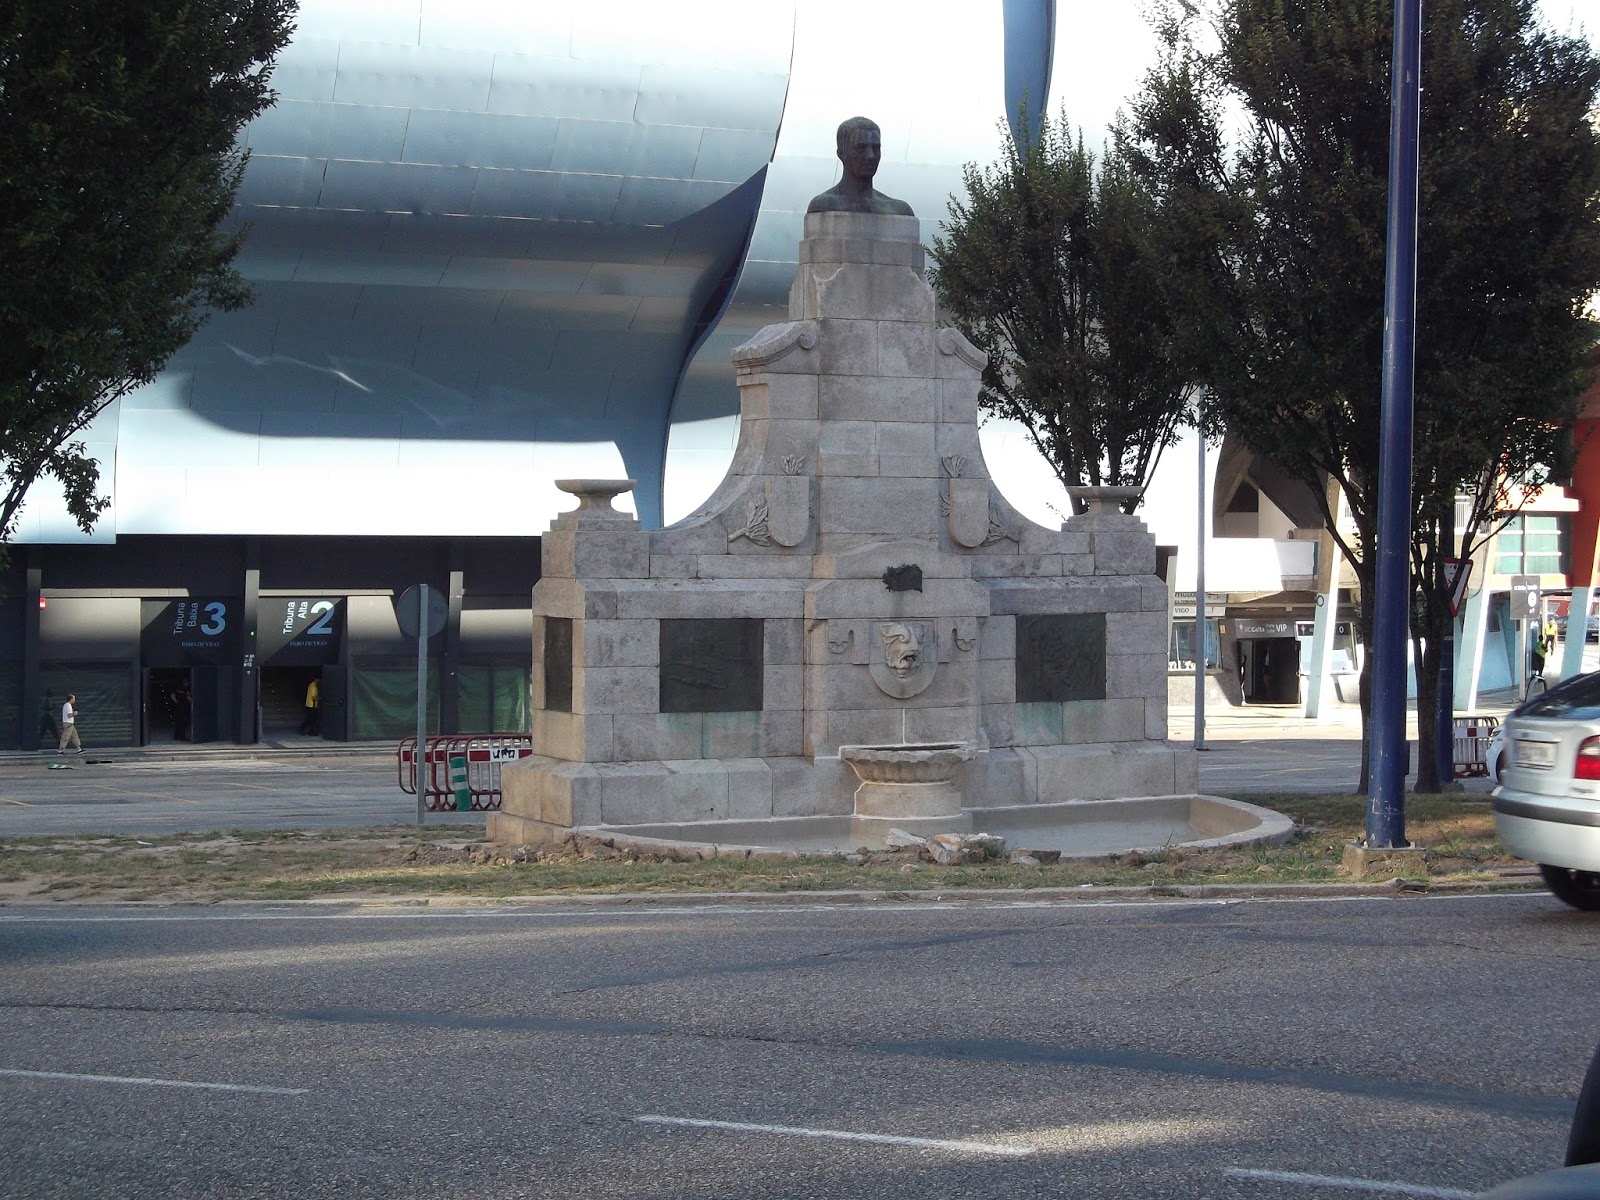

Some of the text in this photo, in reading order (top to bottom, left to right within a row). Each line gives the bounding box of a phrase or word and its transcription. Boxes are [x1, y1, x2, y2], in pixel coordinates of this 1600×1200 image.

[173, 602, 186, 635] Tribuna
[187, 602, 199, 627] Baixa
[200, 601, 226, 636] 3
[282, 602, 296, 635] Tribuna
[297, 602, 309, 619] Alta
[306, 600, 335, 635] 2
[1275, 623, 1288, 633] VIP
